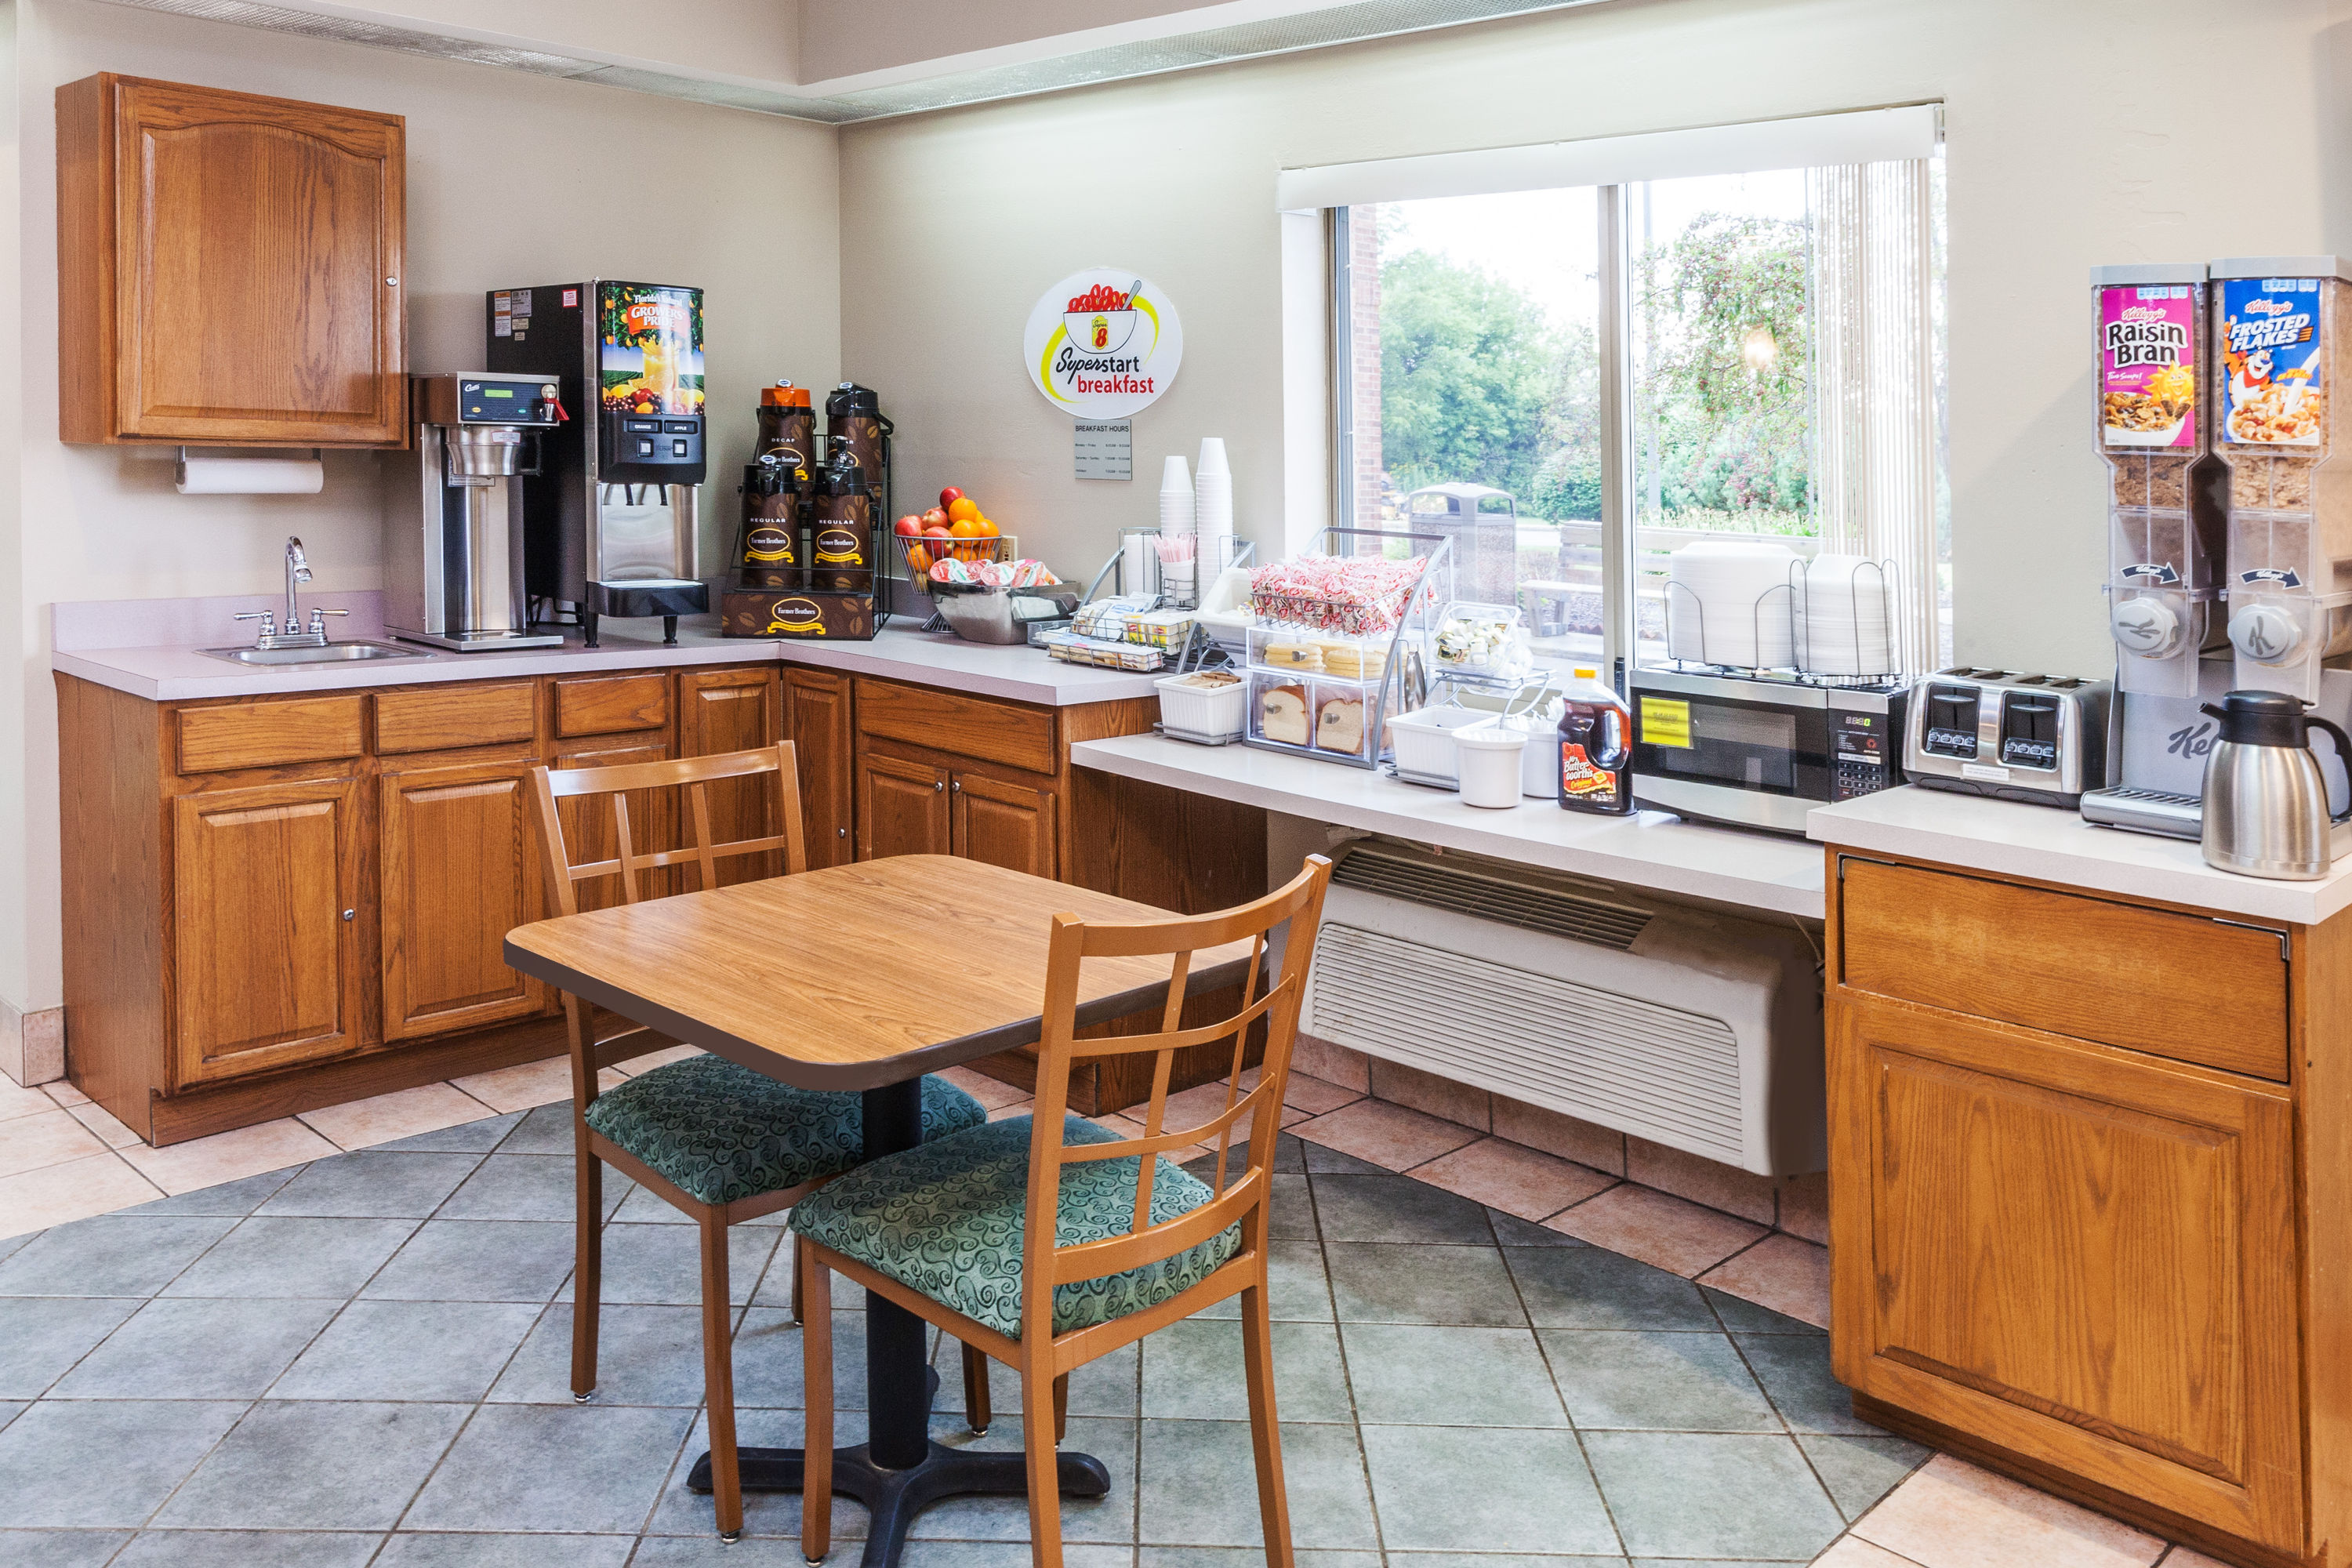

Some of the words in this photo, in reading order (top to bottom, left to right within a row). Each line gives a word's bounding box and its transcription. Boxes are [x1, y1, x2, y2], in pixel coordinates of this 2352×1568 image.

[633, 294, 661, 303] Florida's
[2245, 299, 2293, 316] Kellogg's
[644, 316, 676, 328] PRIDE
[2122, 307, 2166, 321] Kellogg's
[2108, 322, 2185, 347] Raisin
[2229, 314, 2310, 339] FROSTED
[1095, 328, 1107, 347] 8
[2230, 328, 2299, 352] FLAKES
[2117, 344, 2176, 365] Bran
[1056, 347, 1139, 385] Superstart
[1078, 374, 1154, 394] breakfast
